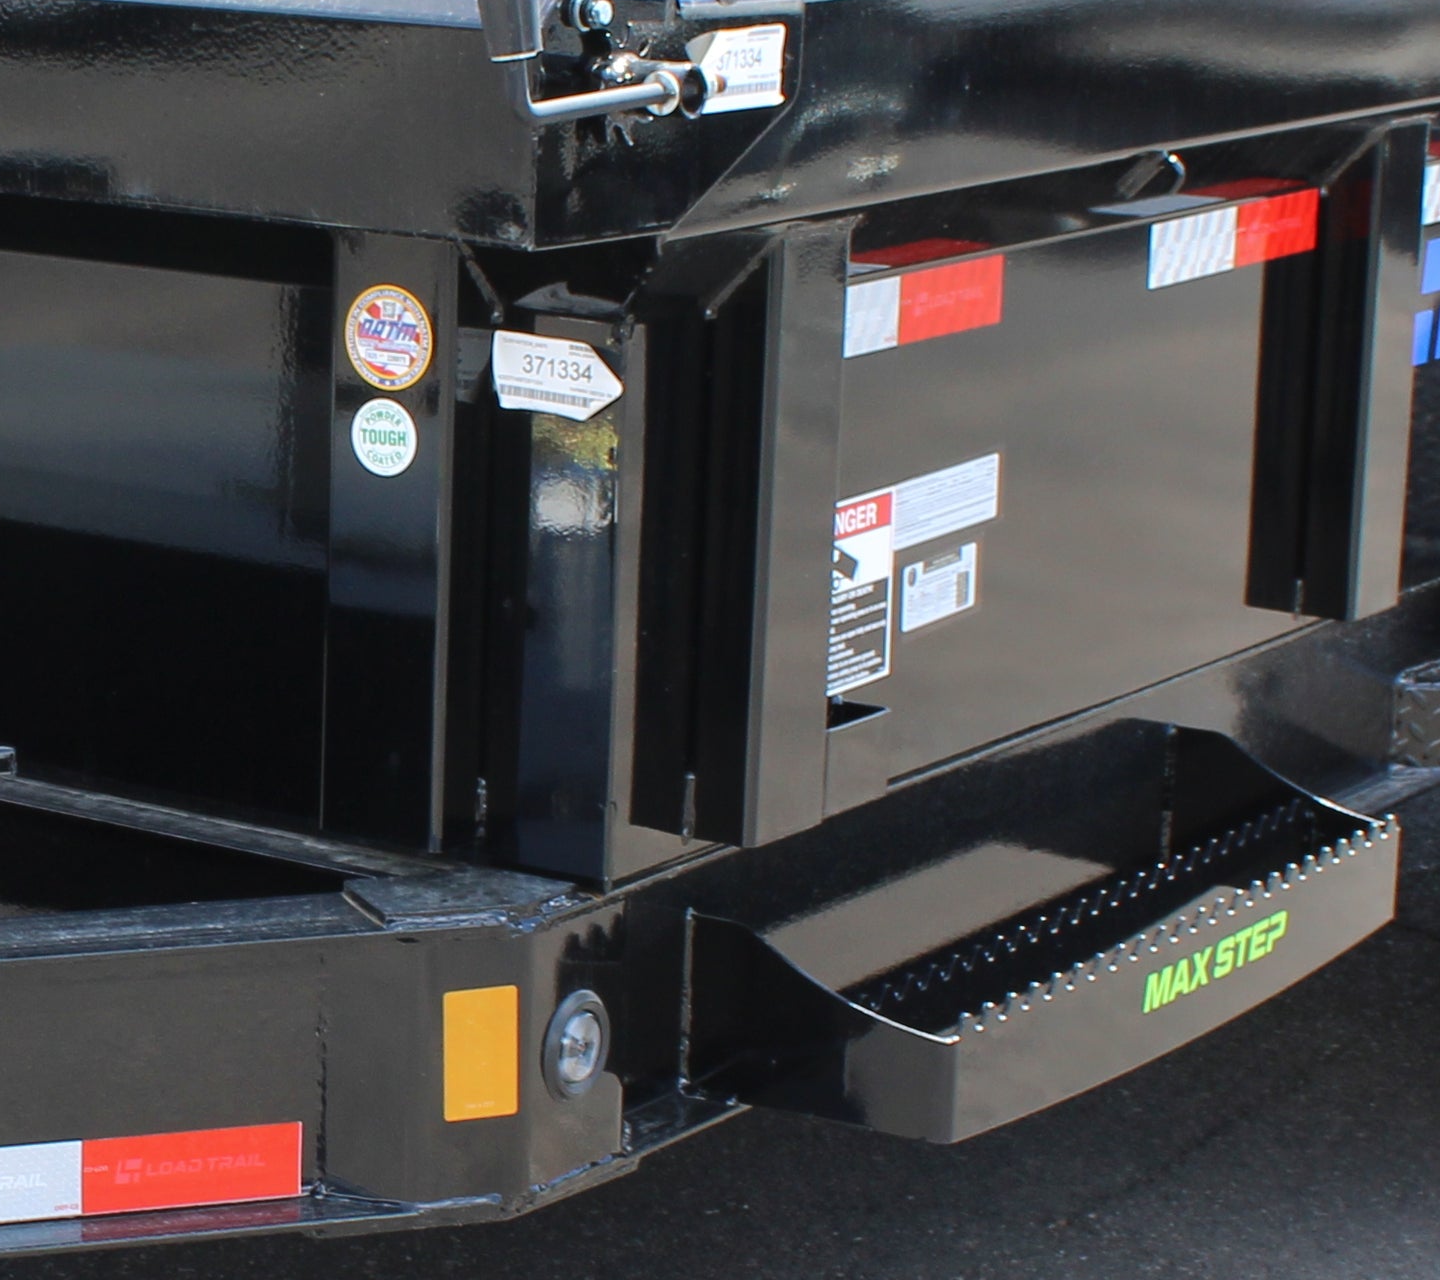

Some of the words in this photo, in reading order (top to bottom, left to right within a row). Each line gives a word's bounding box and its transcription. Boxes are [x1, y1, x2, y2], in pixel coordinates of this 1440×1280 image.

[522, 354, 592, 383] 371334
[361, 428, 407, 447] TOUGH
[834, 503, 878, 536] NGER
[1142, 946, 1213, 1014] MAX
[1213, 910, 1288, 979] STEP
[146, 1158, 205, 1178] LOAD
[206, 1152, 266, 1172] TRAIL
